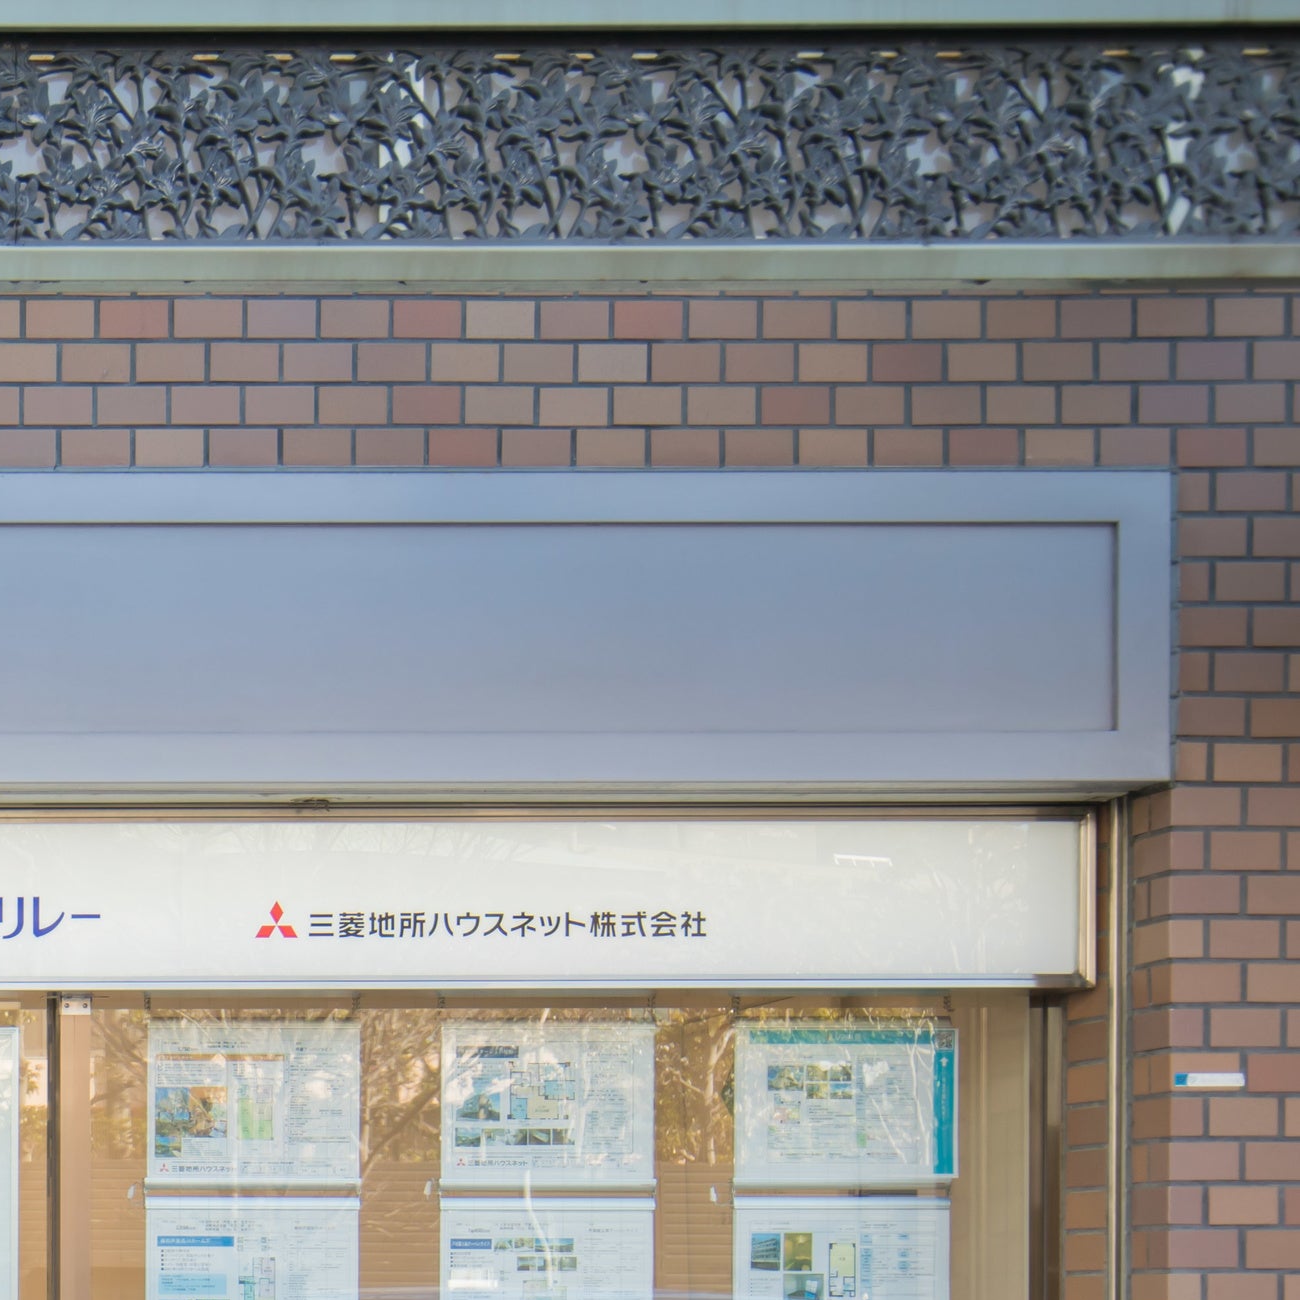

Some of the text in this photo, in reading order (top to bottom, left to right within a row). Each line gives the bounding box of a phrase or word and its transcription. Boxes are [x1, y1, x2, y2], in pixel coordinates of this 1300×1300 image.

[308, 911, 707, 938] 三菱地所ハウスネット株式会社
